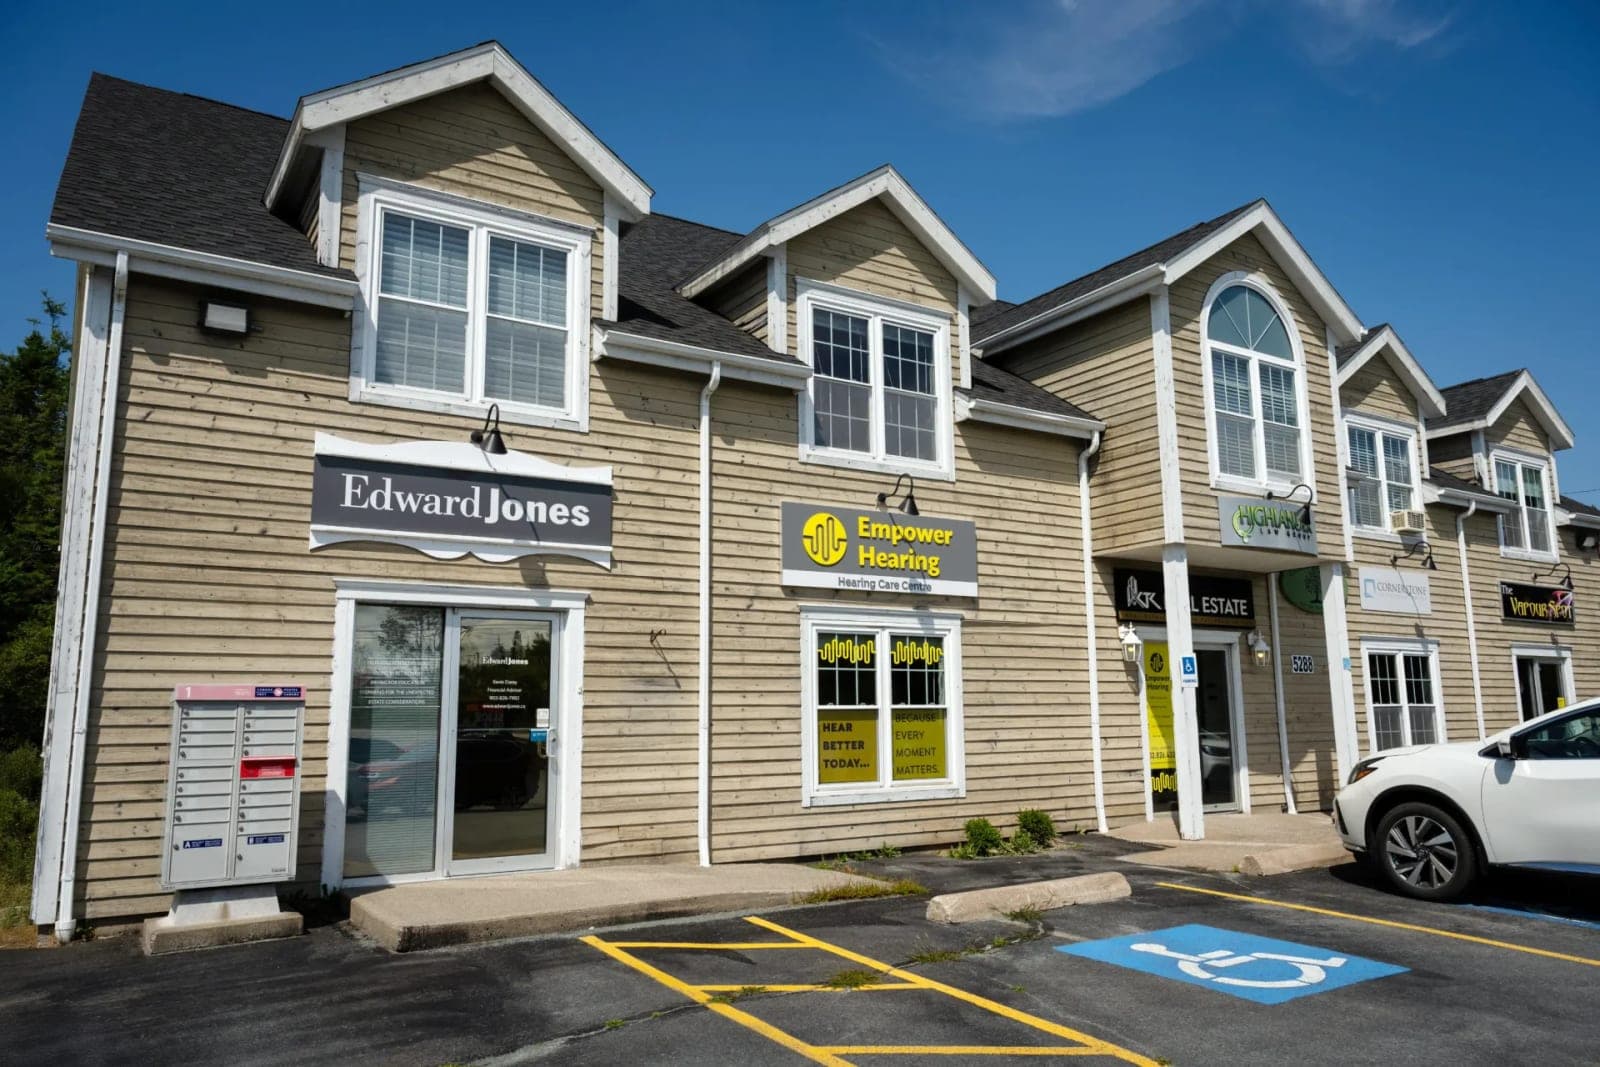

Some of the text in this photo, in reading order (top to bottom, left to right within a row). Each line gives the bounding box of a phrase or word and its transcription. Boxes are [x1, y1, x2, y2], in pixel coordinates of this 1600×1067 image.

[340, 473, 590, 526] Edward Jones
[857, 516, 953, 546] Empower
[857, 544, 941, 577] Hearing
[838, 576, 932, 593] Hearing Care Centre
[1501, 584, 1514, 594] The
[1202, 597, 1249, 616] ESTATE
[1293, 655, 1313, 673] 5288
[185, 686, 192, 698] 1
[895, 712, 937, 722] BECAUSE
[823, 722, 853, 732] HEAR
[895, 731, 925, 741] EVERY
[823, 740, 865, 751] BETTER
[896, 747, 936, 758] MOMENT
[823, 758, 870, 769] TODAY...
[896, 764, 940, 775] MATTERS.
